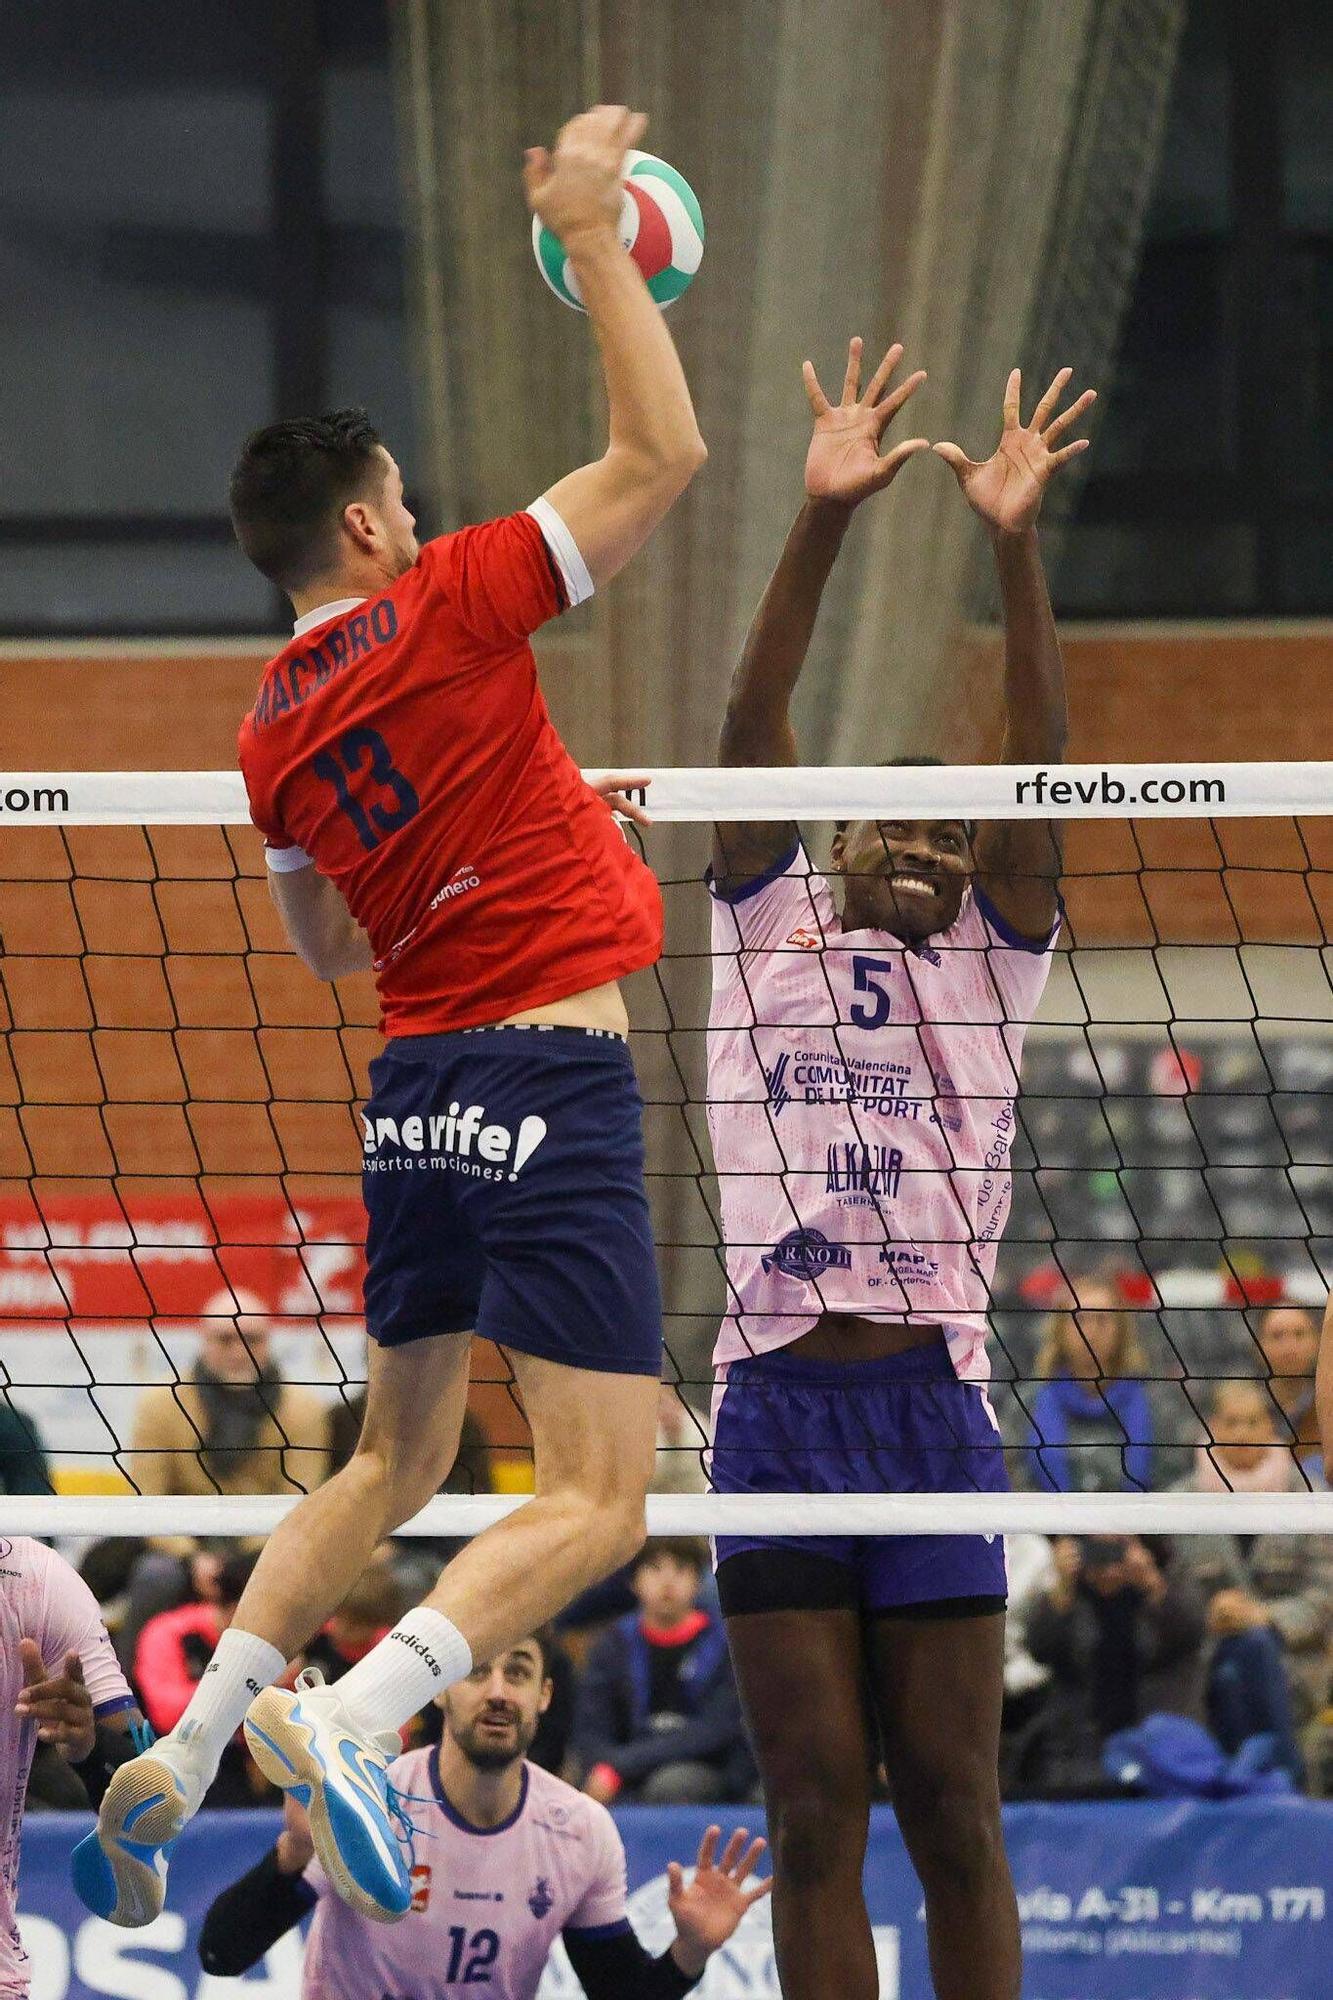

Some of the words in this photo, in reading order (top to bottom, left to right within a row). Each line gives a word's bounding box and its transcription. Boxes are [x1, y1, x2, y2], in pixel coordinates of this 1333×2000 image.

[0, 788, 69, 812] om
[313, 726, 420, 851] 13
[1015, 771, 1226, 804] rfevb.com
[849, 955, 892, 1031] 5
[793, 1065, 910, 1097] COMUNITAT
[847, 1057, 912, 1076] Valenciana
[828, 1087, 923, 1121] L'EPORT
[825, 1142, 903, 1199] ALKAZAR
[391, 1630, 443, 1678] adidas
[1191, 1885, 1264, 1923] Km
[446, 1926, 500, 1984] 12
